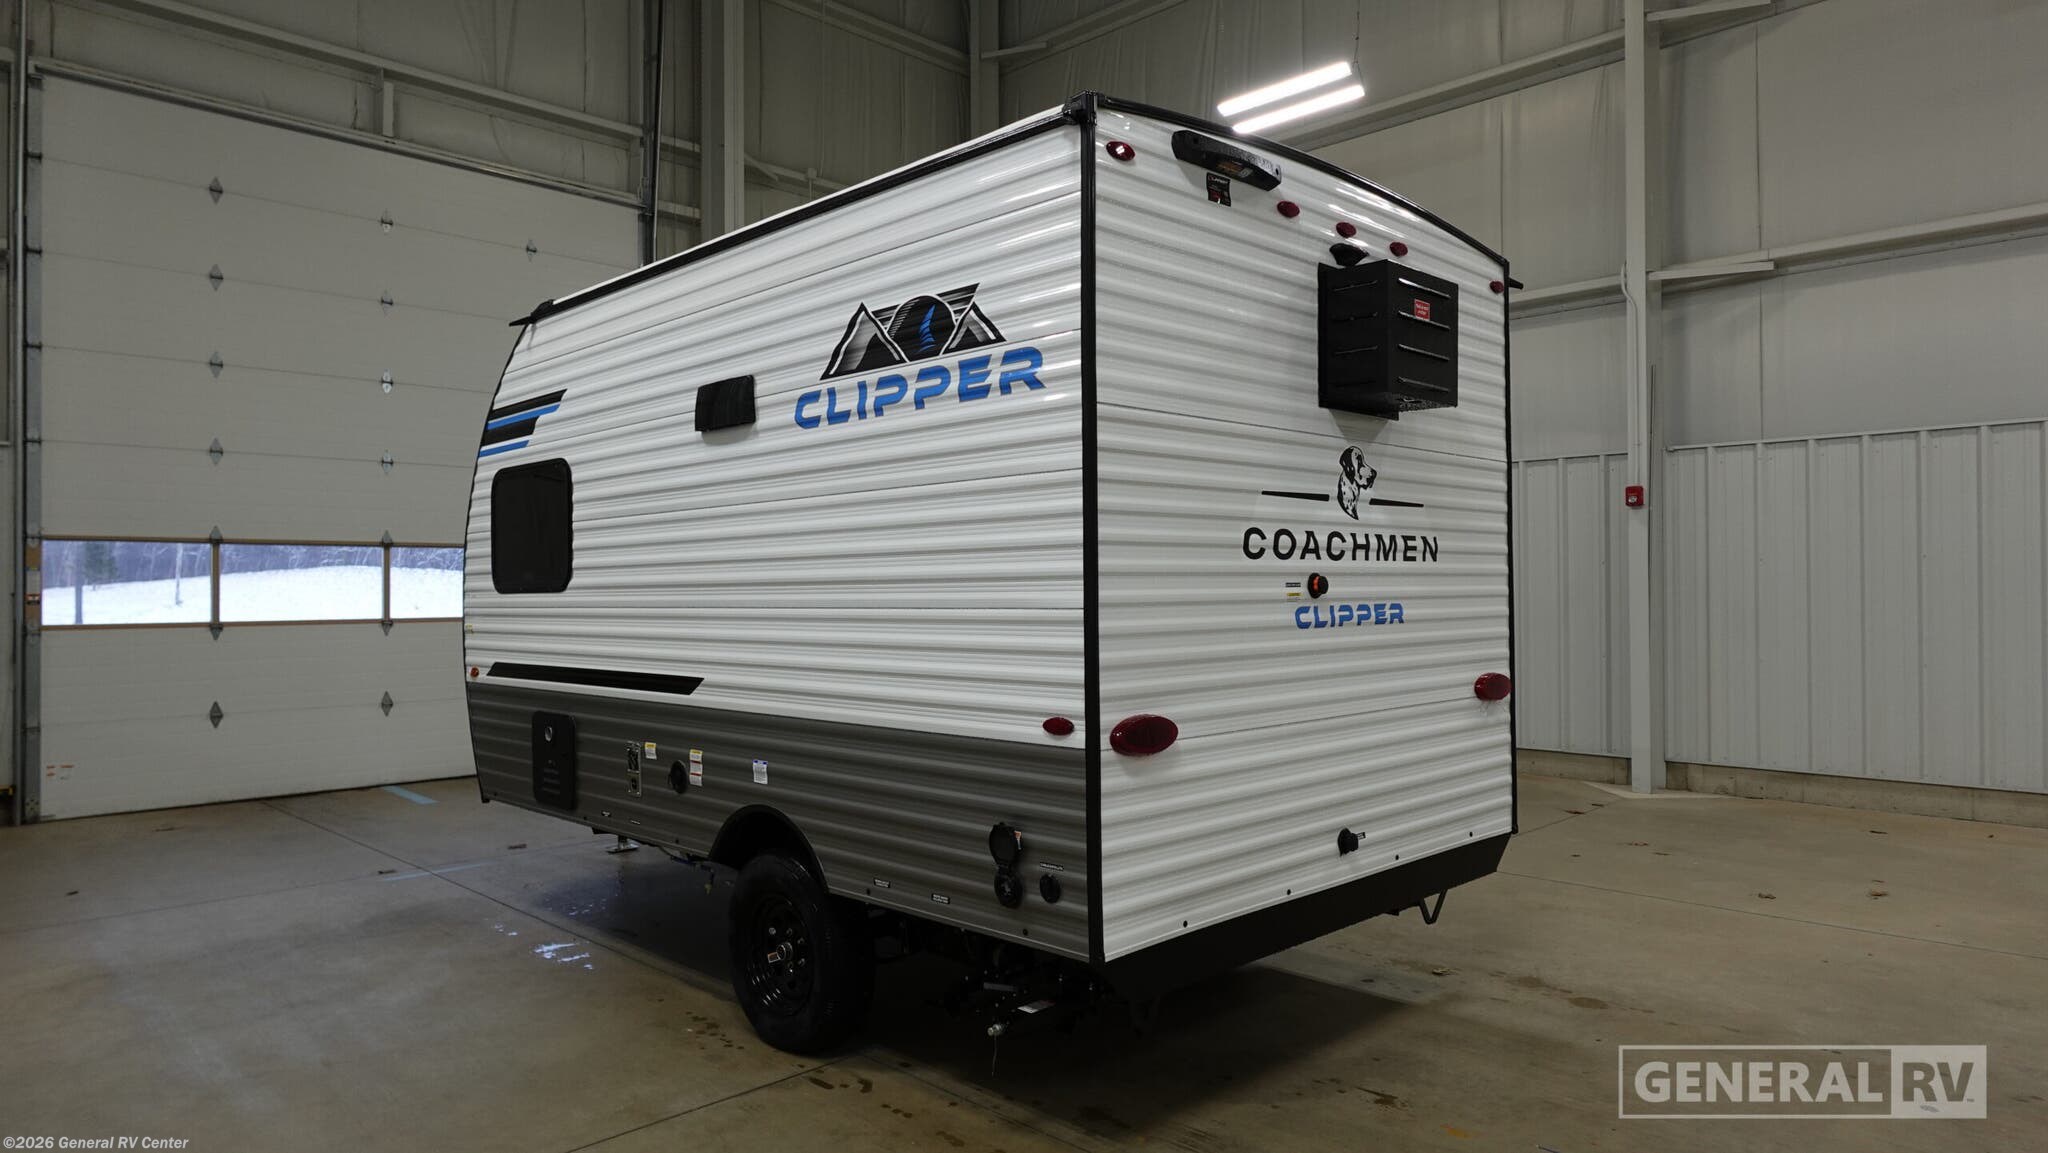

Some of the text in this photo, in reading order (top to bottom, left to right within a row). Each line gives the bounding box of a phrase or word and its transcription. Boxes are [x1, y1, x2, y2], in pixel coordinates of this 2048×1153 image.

[794, 346, 1046, 430] CLIPPER
[1242, 526, 1439, 562] COACHMEN
[1294, 602, 1405, 630] CLIPPER
